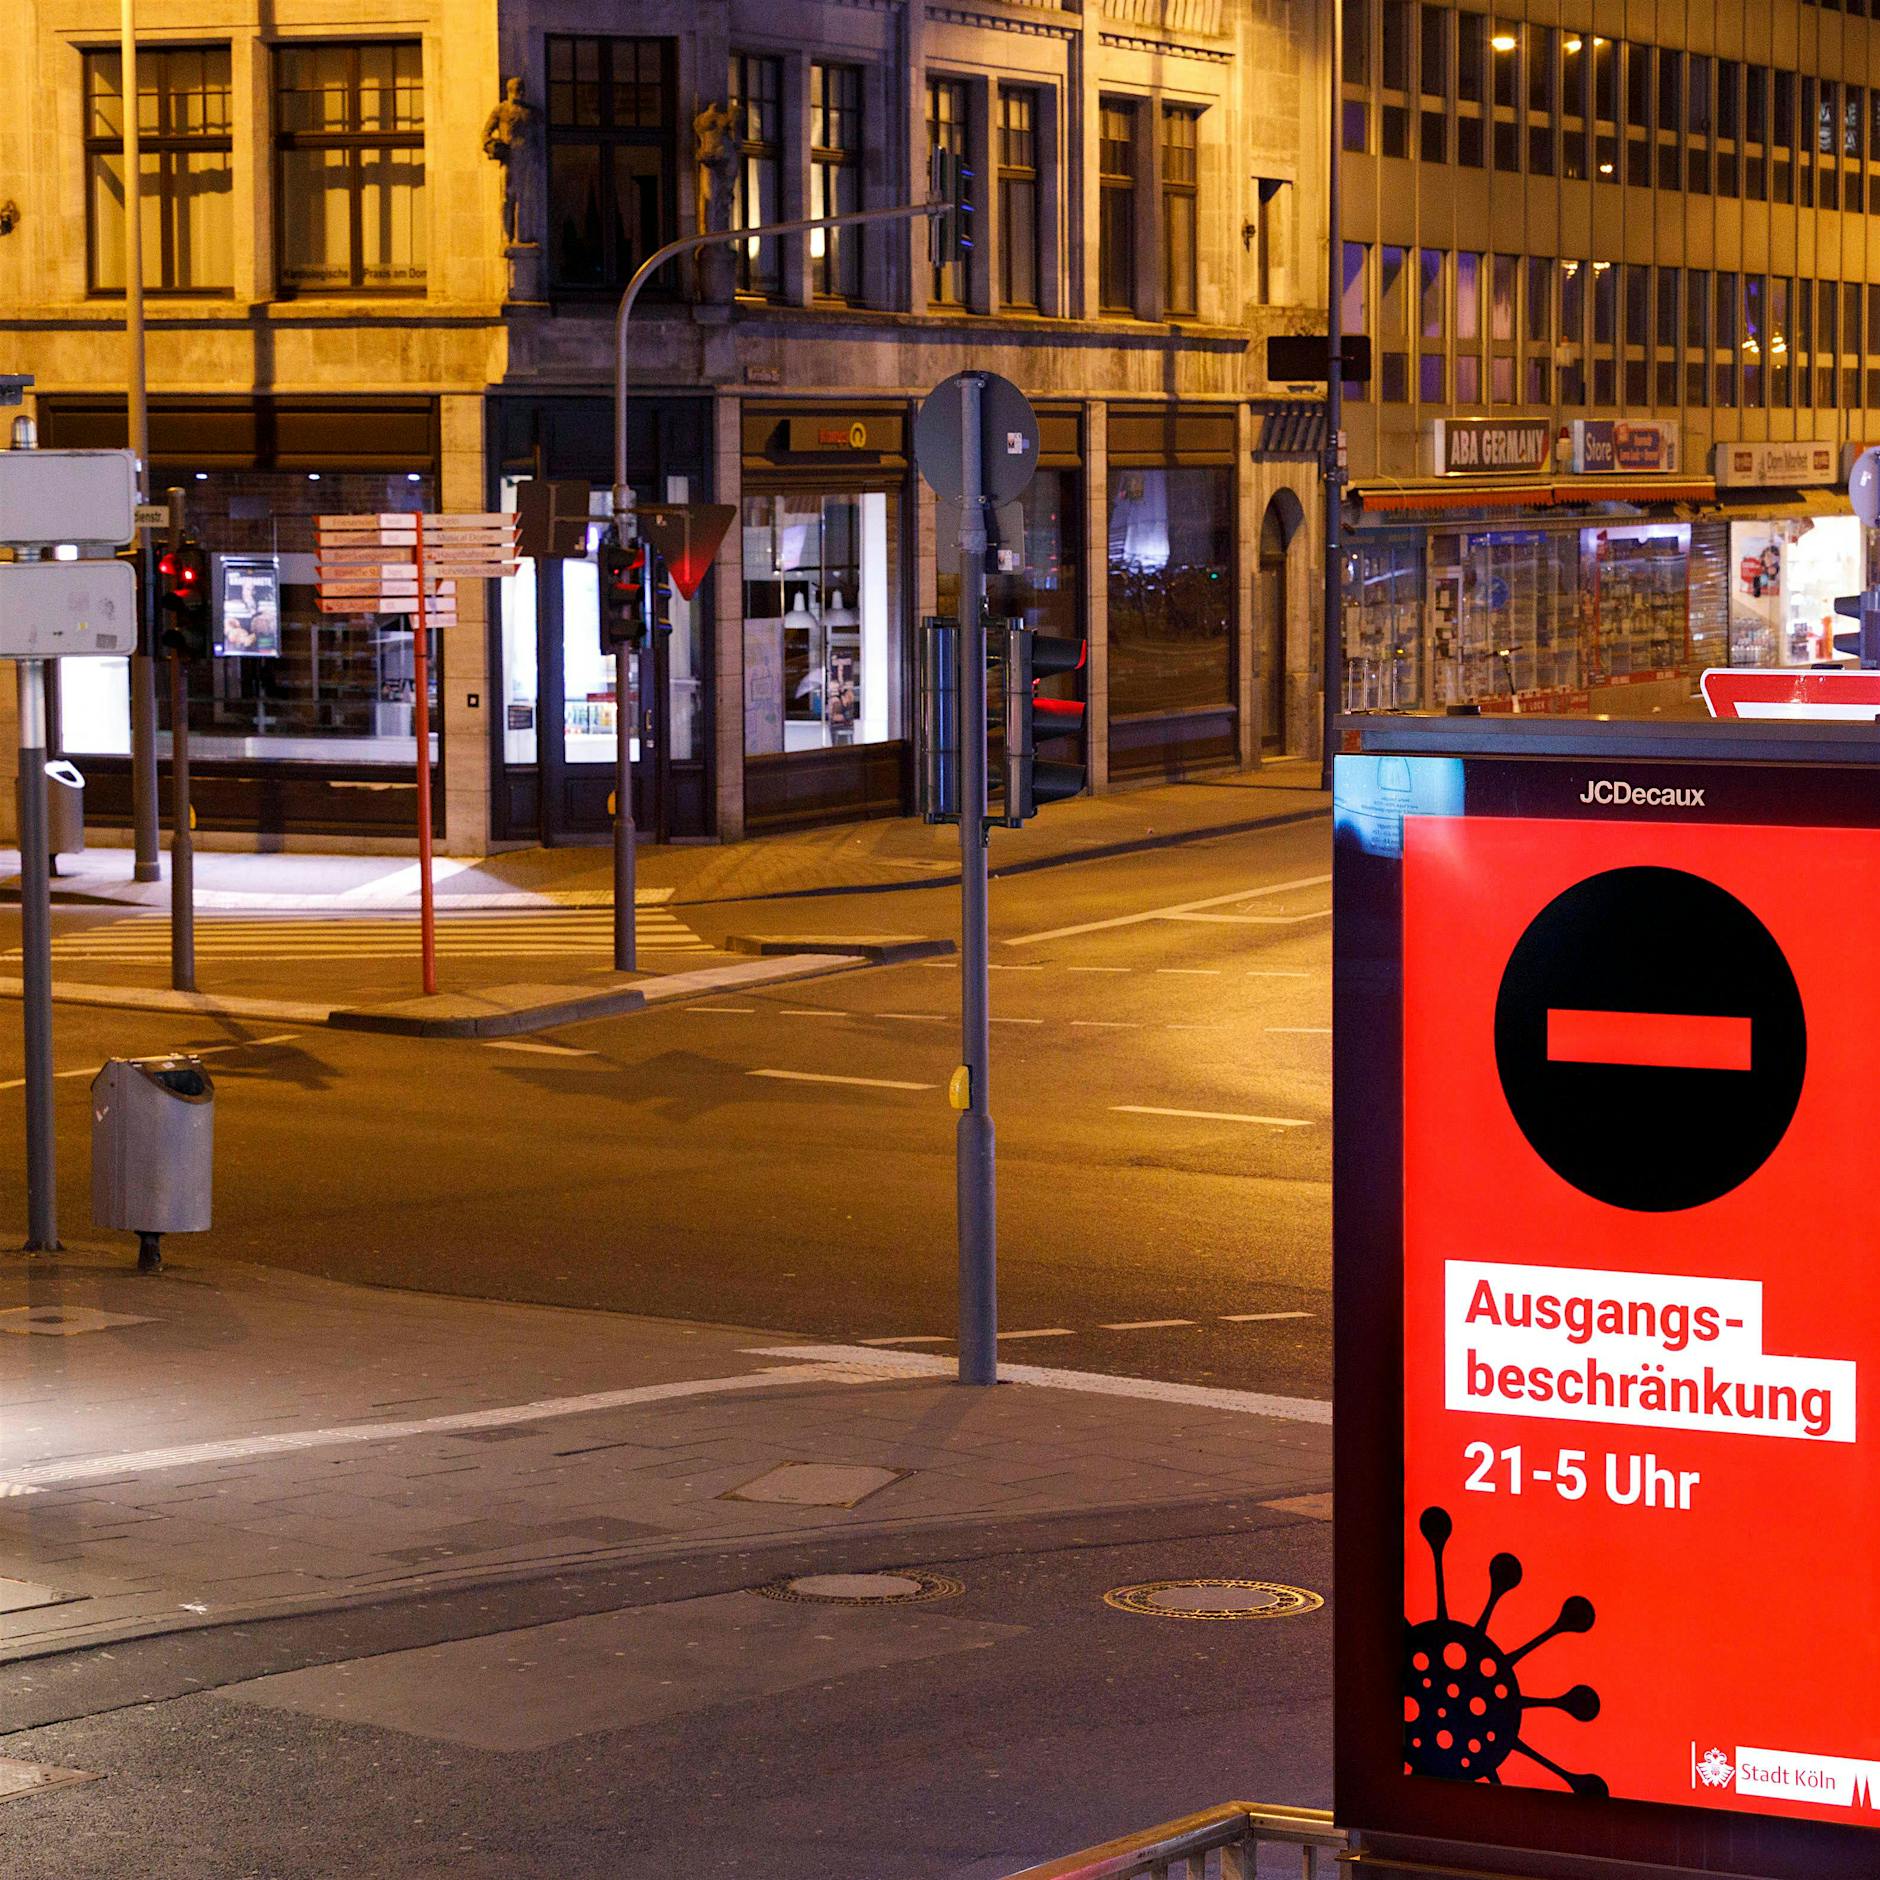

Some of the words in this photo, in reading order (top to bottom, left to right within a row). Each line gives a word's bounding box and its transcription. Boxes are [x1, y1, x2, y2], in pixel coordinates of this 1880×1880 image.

[1451, 430, 1479, 465] ABA
[1482, 429, 1544, 465] GERMANY
[1585, 432, 1612, 461] Store
[436, 533, 467, 542] Musical
[469, 533, 494, 542] Dome
[1580, 780, 1706, 806] JCDecaux
[1465, 1279, 1743, 1352] Ausgangs-
[1467, 1348, 1832, 1436] beschränkung
[1463, 1441, 1588, 1501] 21-5
[1605, 1452, 1700, 1510] Uhr
[1741, 1763, 1790, 1785] Stadt
[1795, 1769, 1836, 1790] Köln
